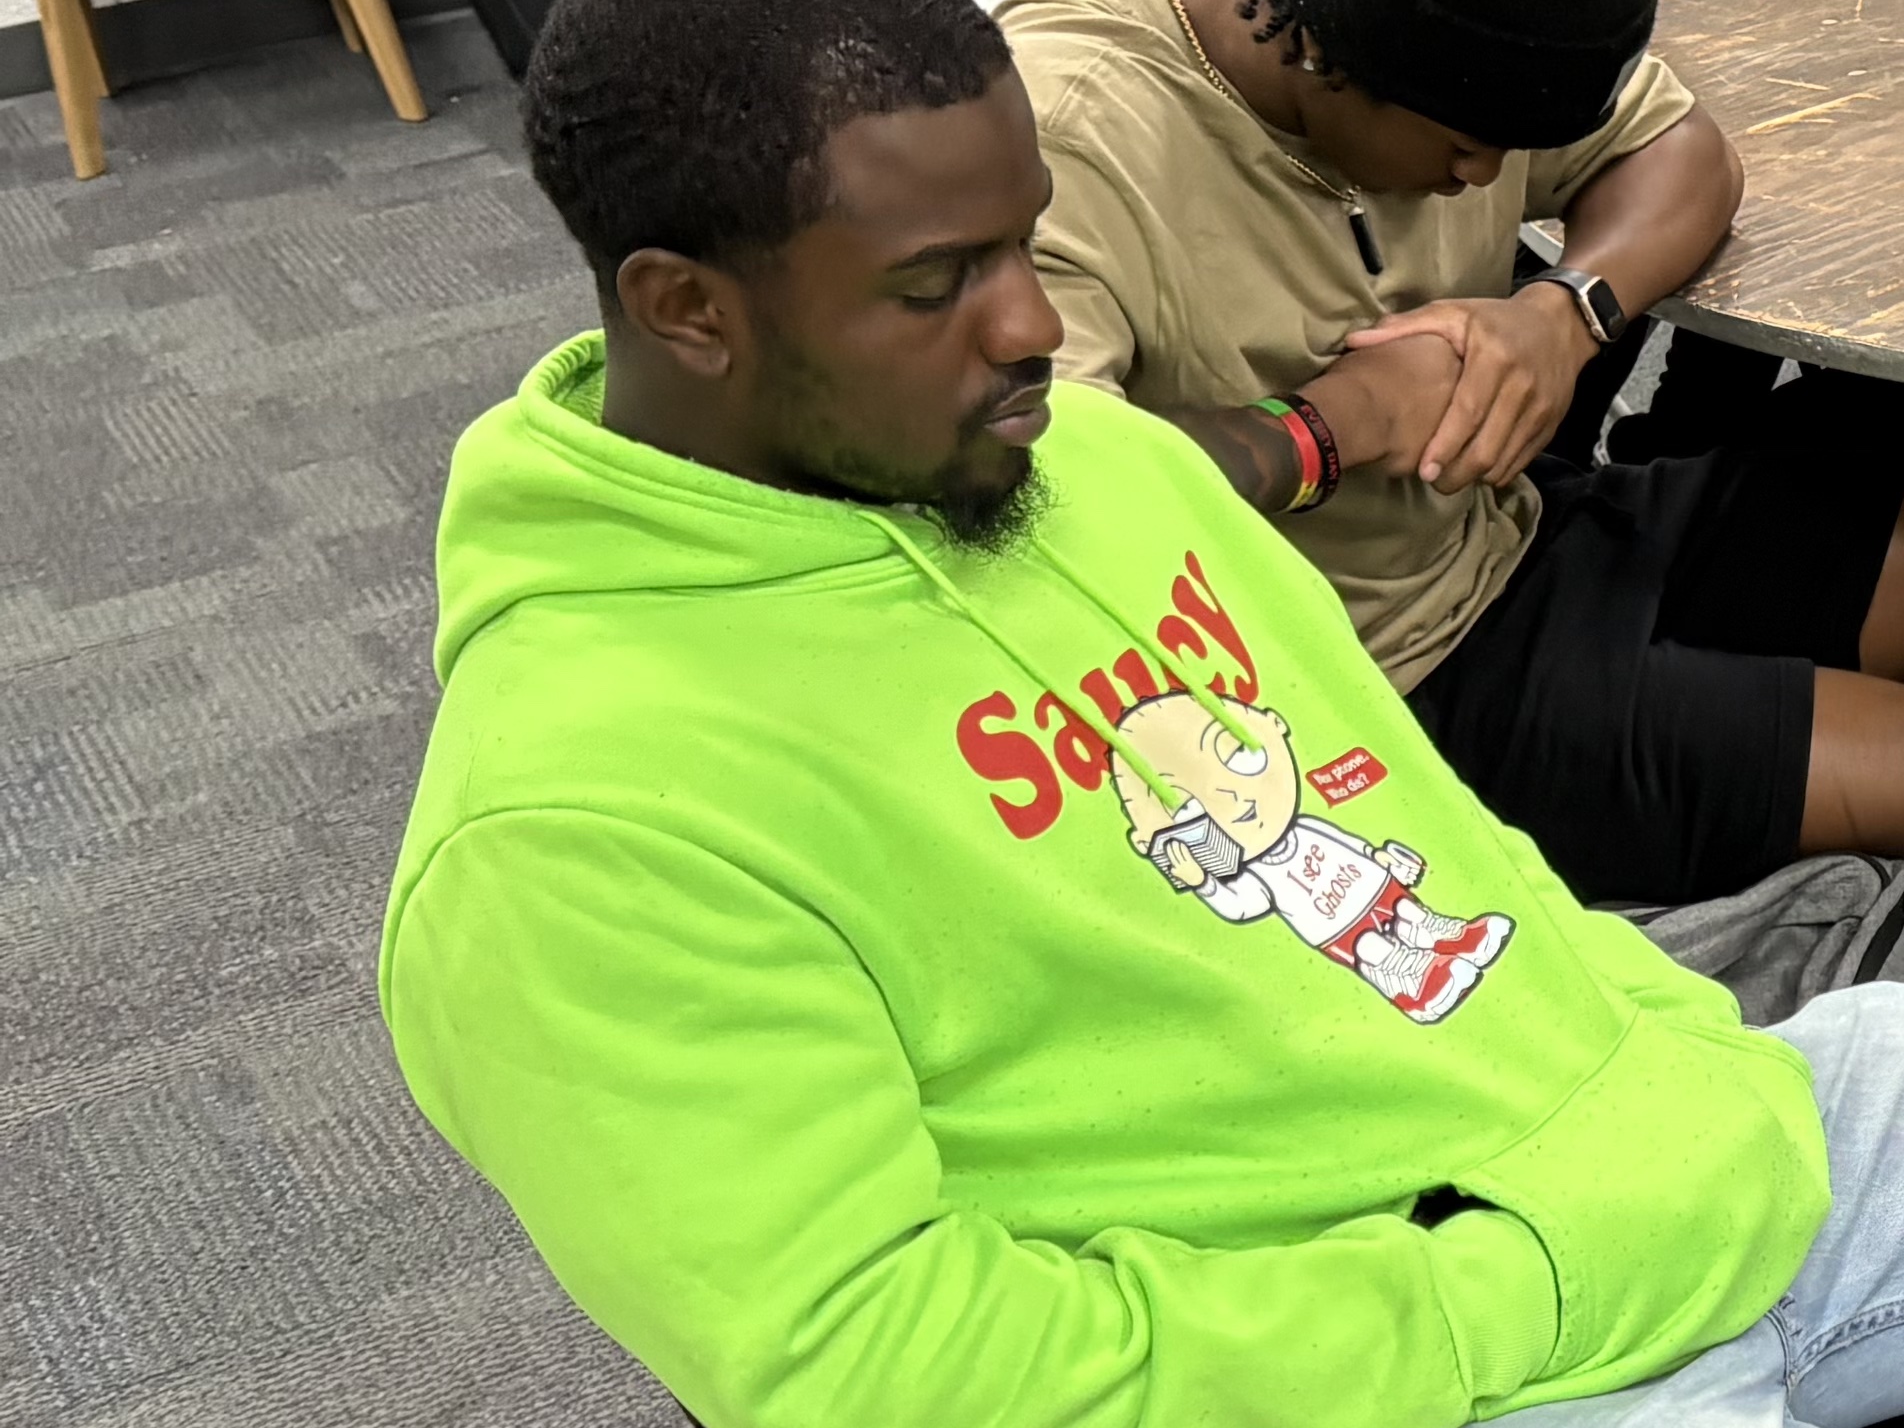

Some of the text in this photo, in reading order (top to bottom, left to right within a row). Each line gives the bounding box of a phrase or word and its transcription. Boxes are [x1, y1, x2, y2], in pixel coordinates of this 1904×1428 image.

[957, 549, 1259, 840] Saucy
[1287, 843, 1325, 897] I see
